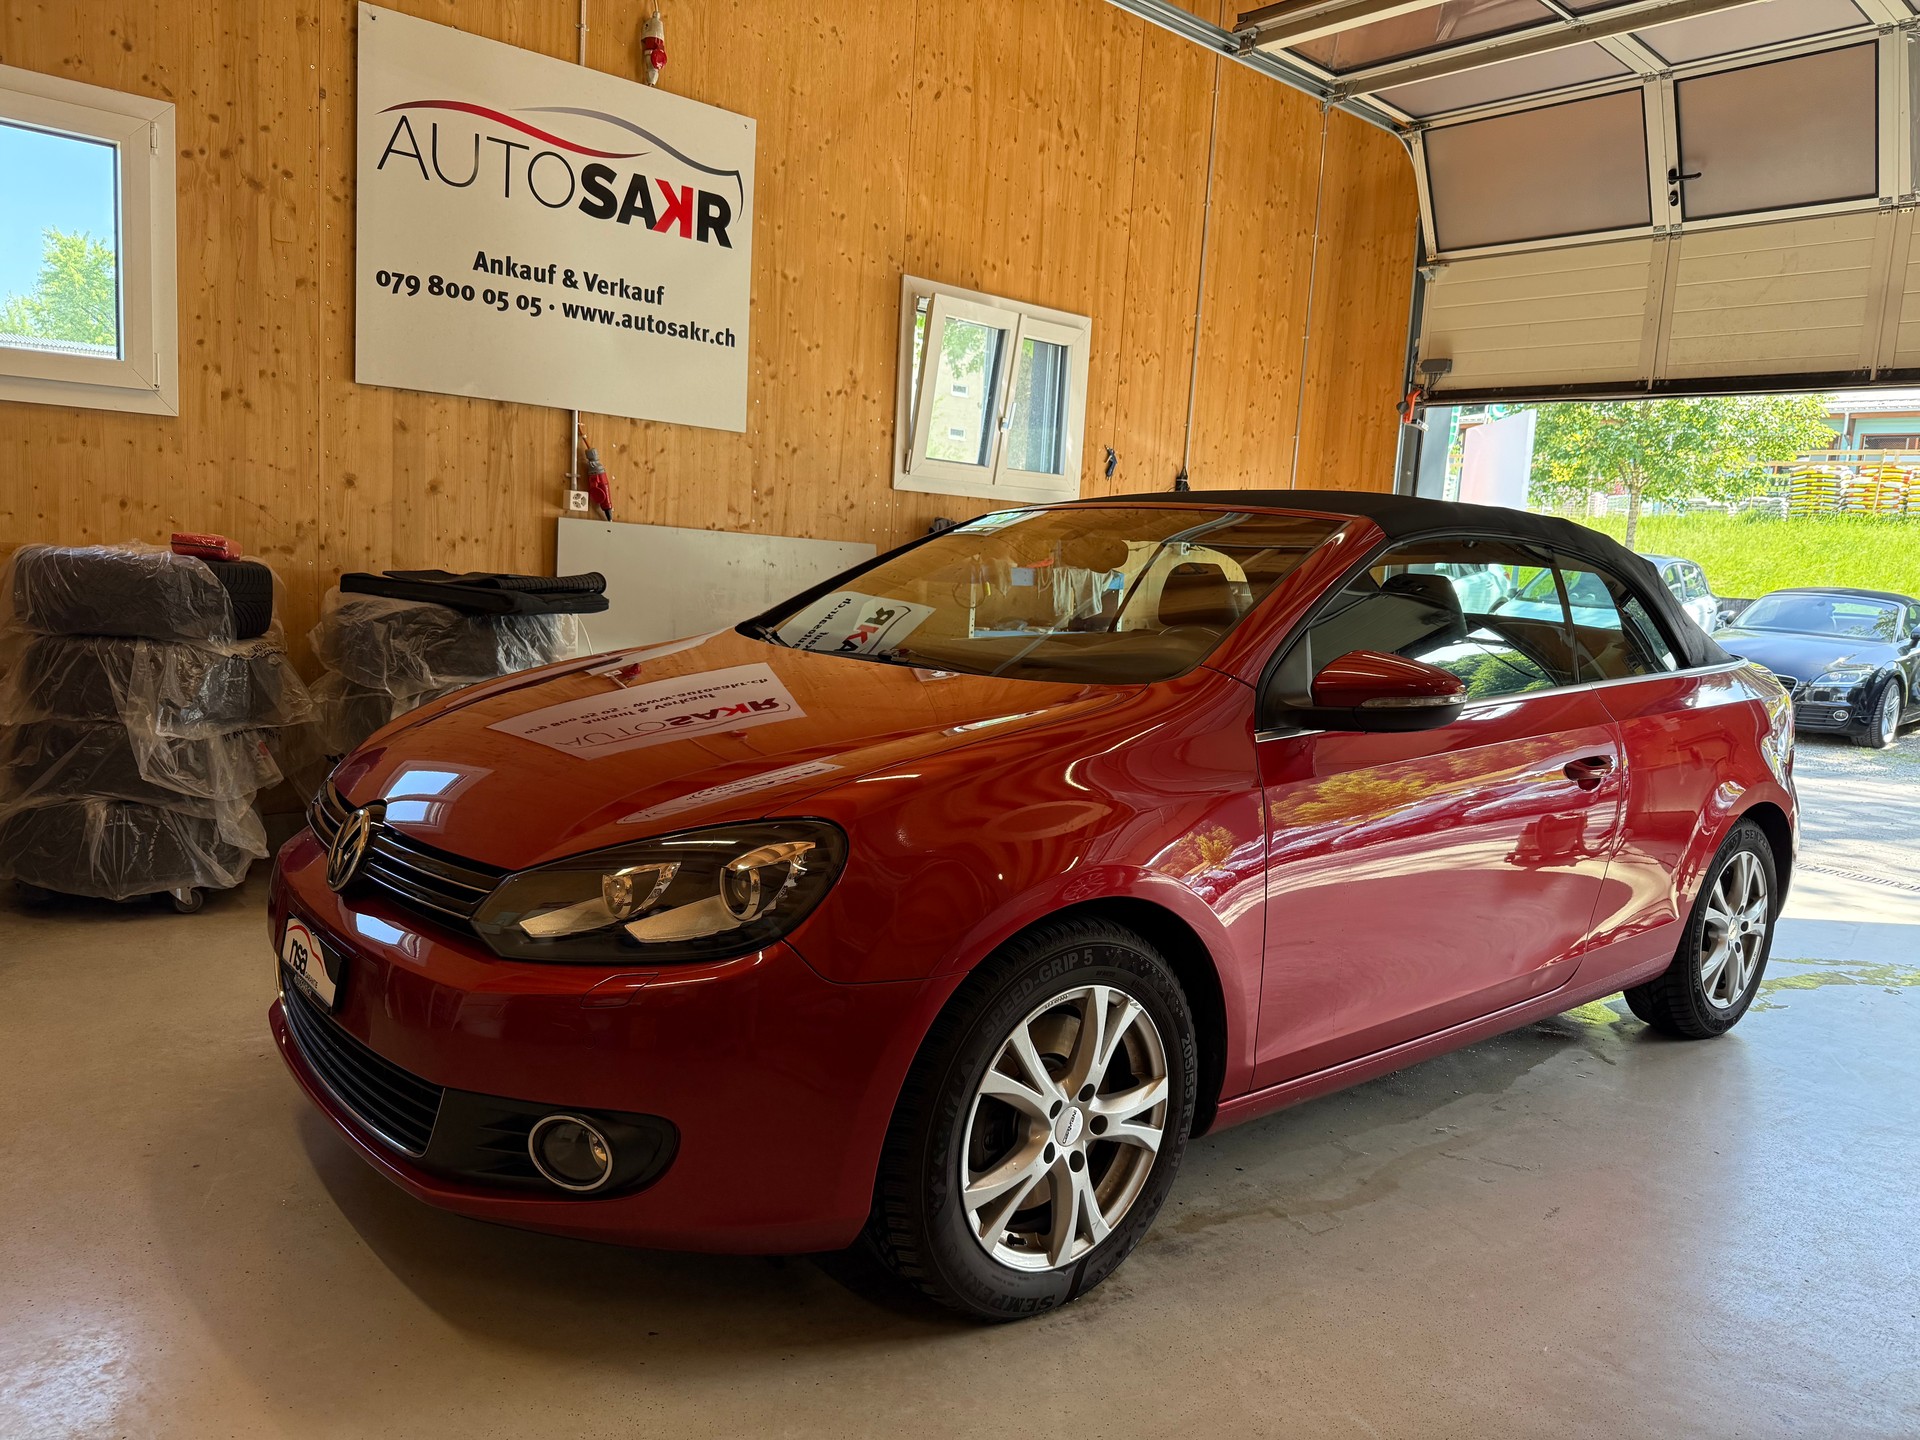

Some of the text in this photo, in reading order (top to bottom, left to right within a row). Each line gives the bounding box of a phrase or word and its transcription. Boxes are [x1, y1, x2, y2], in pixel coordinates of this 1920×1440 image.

[375, 269, 421, 297] 079
[427, 275, 475, 302] 800
[482, 288, 509, 312] 05
[516, 294, 542, 317] 05
[562, 301, 736, 349] www.autosakr.ch
[472, 251, 665, 306] Ankauf & Verkauf
[981, 948, 1094, 1038] SPEED-GRIP 5
[1170, 1032, 1195, 1168] 205/55 R 16 H
